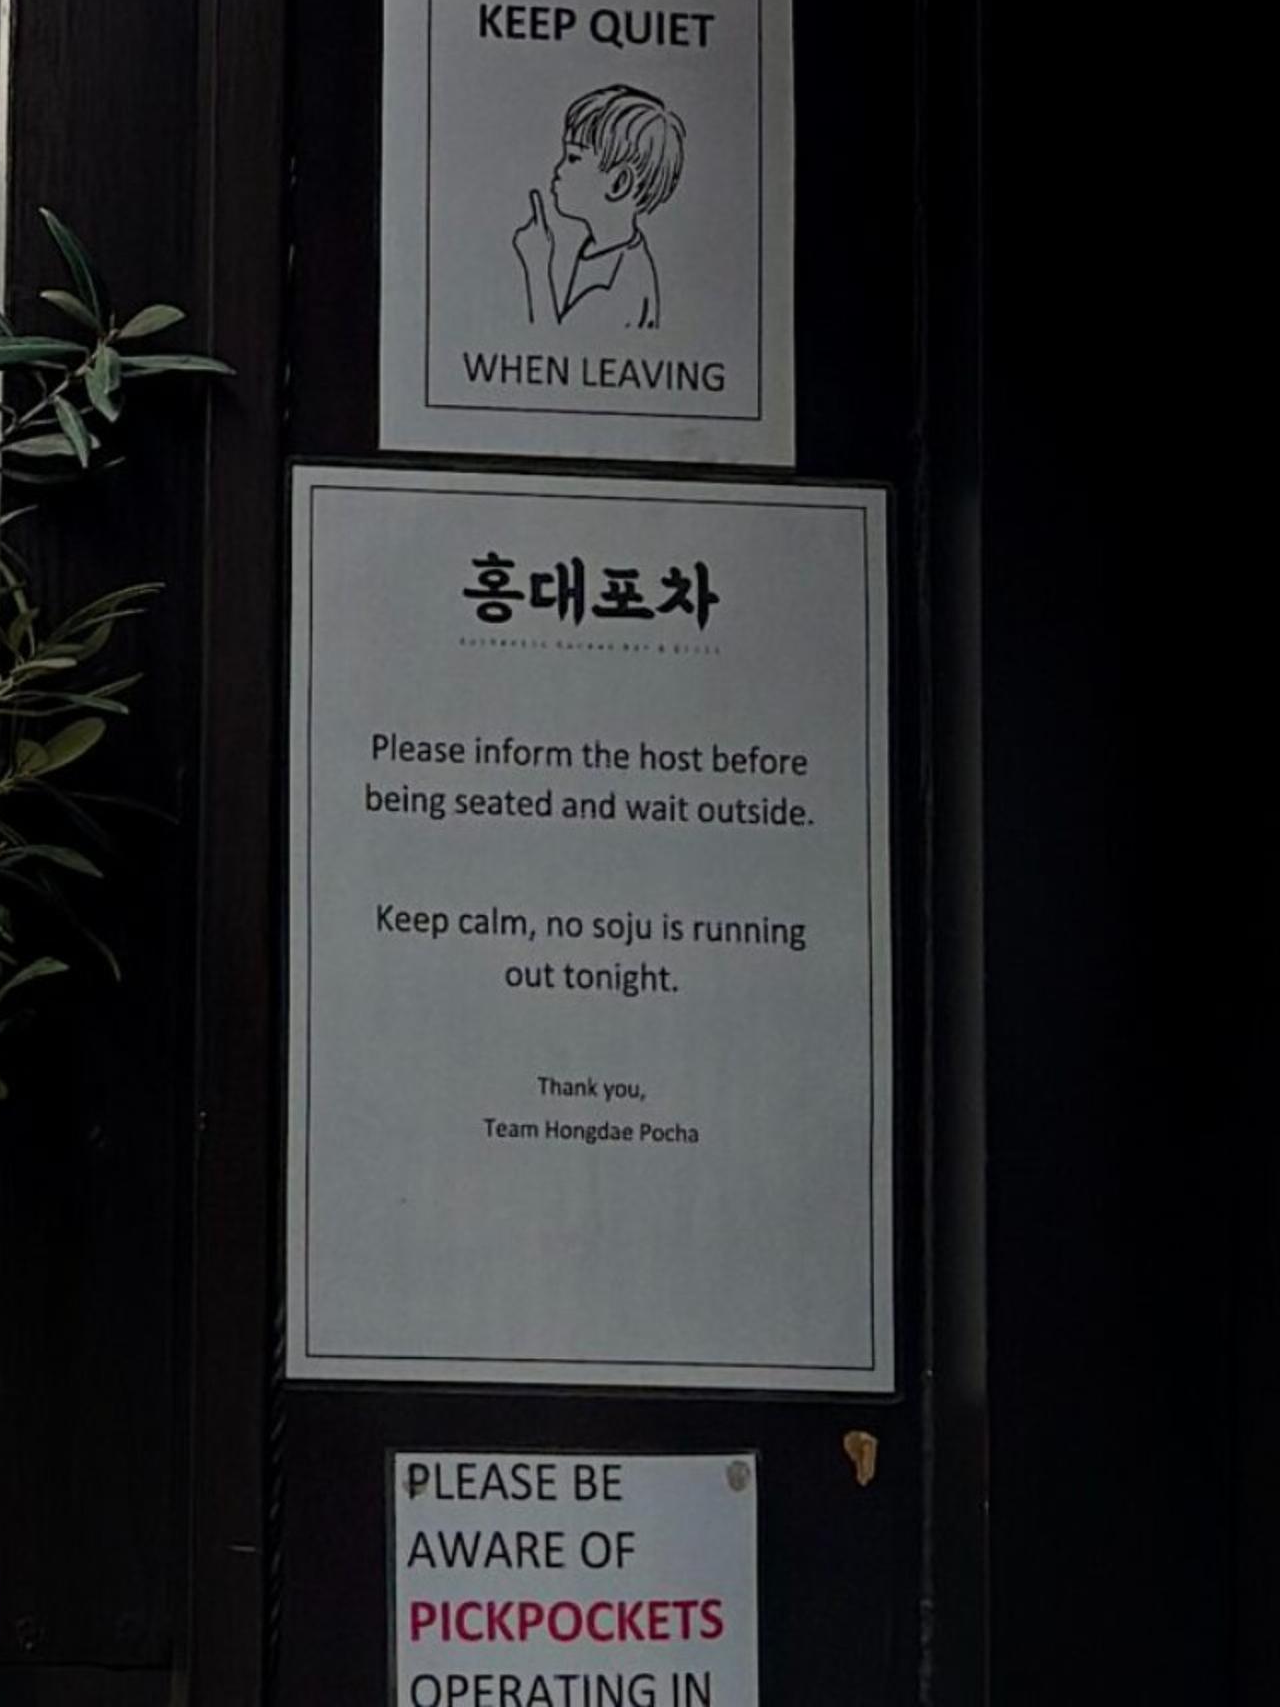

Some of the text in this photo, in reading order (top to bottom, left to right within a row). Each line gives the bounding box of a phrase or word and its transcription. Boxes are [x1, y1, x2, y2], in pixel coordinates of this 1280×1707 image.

[480, 4, 715, 49] KEEP QUIET
[463, 352, 725, 392] WHEN LEAVING
[463, 552, 720, 630] 홍대포차
[373, 733, 807, 776] Please inform the host before
[366, 783, 814, 826] being seated and wait outside.
[377, 905, 806, 951] Keep calm, no soju is running
[505, 963, 678, 997] out tonight.
[537, 1077, 645, 1102] Thank you,
[484, 1118, 699, 1144] Team Hongdae Pocha
[407, 1463, 622, 1501] PLEASE BE
[407, 1531, 635, 1569] AWARE OF
[411, 1599, 723, 1642] PICKPOCKETS
[411, 1671, 710, 1707] OPERATING IN
